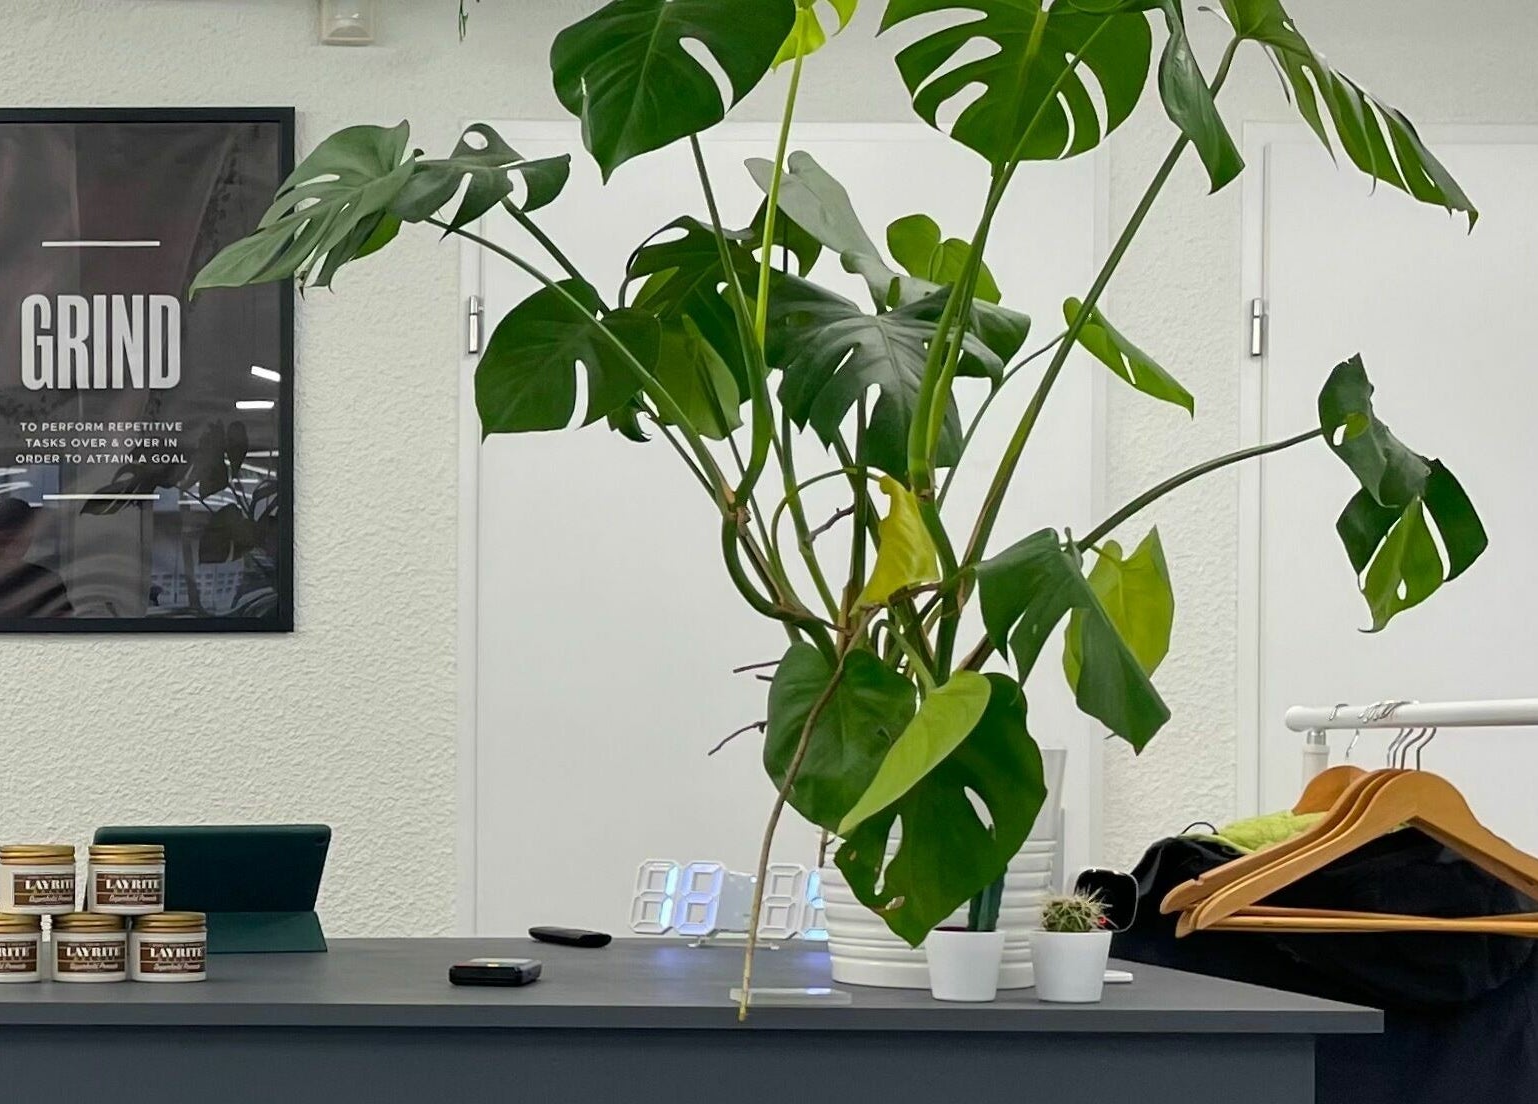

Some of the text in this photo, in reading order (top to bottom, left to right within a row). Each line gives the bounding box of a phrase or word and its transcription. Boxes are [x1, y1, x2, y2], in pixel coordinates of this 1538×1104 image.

[21, 294, 180, 390] GRIND
[20, 422, 183, 432] TO PERFORM REPETITIVE
[25, 438, 177, 448] TASKS OVER & OVER IN
[15, 454, 188, 464] ORDER TO ATTAIN A GOAL
[65, 947, 120, 957] LAYRITE
